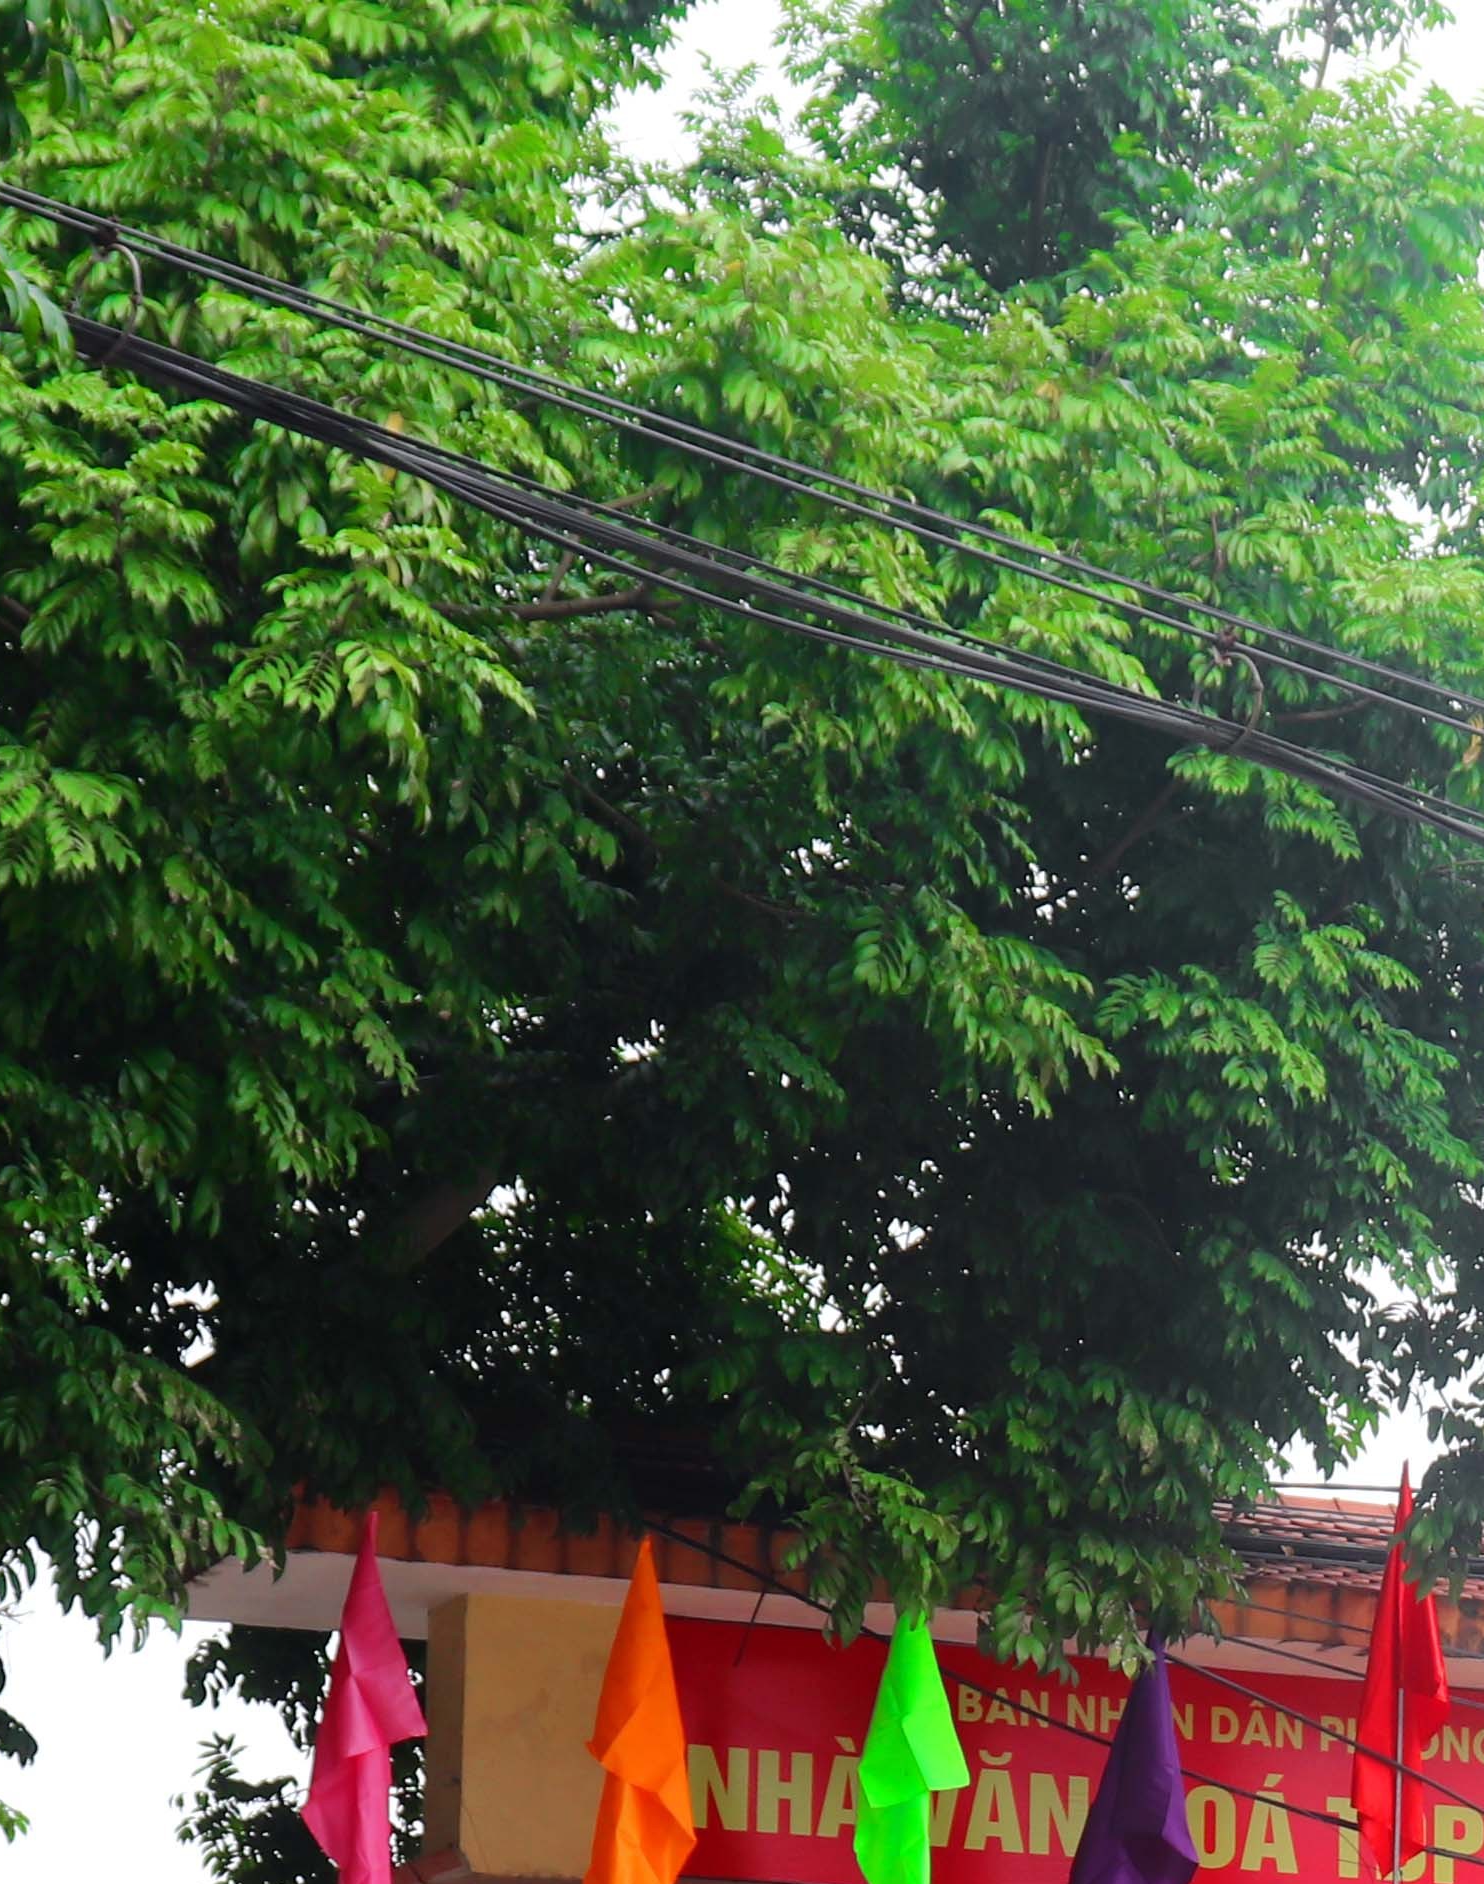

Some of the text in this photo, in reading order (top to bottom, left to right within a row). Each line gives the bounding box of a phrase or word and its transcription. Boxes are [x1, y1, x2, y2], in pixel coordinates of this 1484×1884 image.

[957, 1683, 1050, 1730] BAN
[1067, 1692, 1194, 1741] NHN
[1211, 1702, 1304, 1751] DÂN
[1185, 1773, 1299, 1875] OÁ
